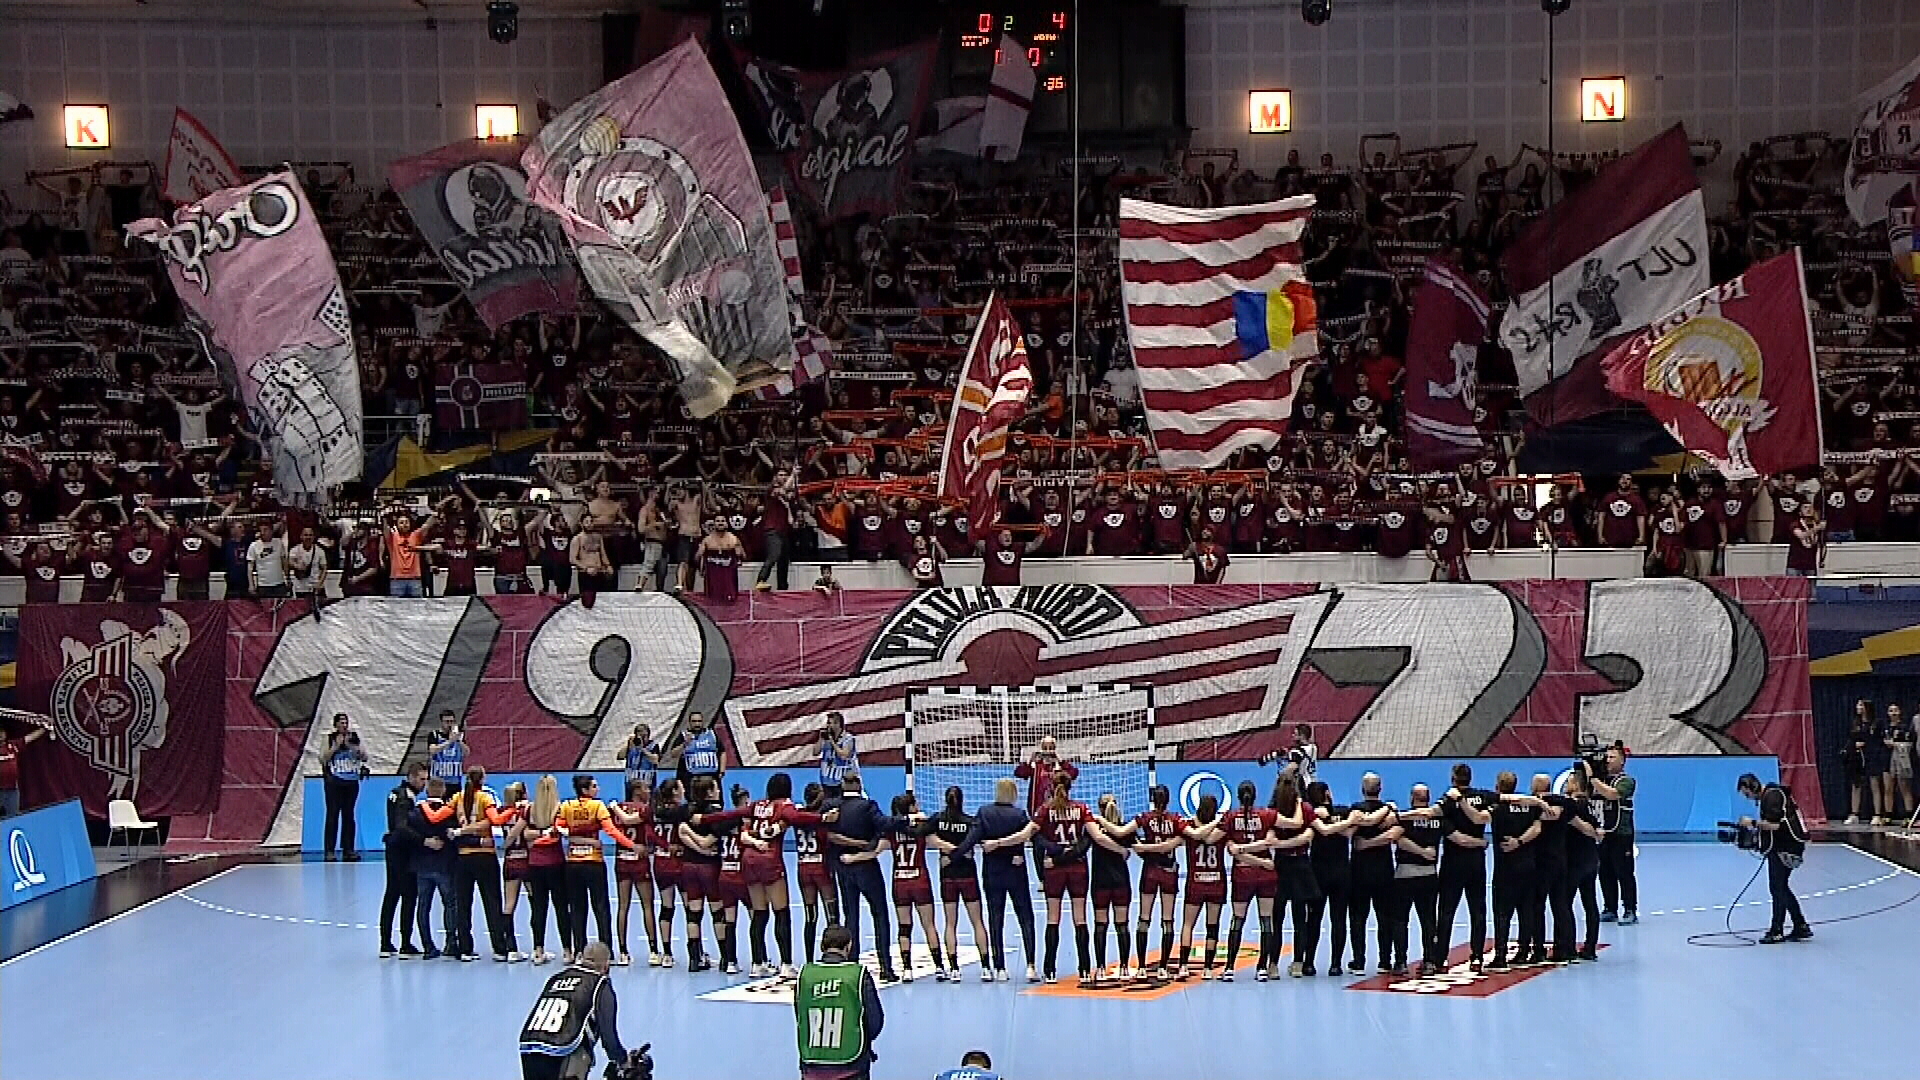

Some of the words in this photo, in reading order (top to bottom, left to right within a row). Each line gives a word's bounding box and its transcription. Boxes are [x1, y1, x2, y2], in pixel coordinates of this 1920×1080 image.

[1004, 15, 1013, 31] 2
[1053, 12, 1065, 29] 4
[1260, 104, 1281, 128] M
[1594, 92, 1615, 116] N
[76, 117, 98, 142] K
[1054, 823, 1078, 845] 11
[896, 843, 918, 867] 17
[1195, 844, 1218, 868] 18
[813, 978, 842, 997] EHF
[528, 998, 569, 1032] HB
[808, 1007, 844, 1048] RH
